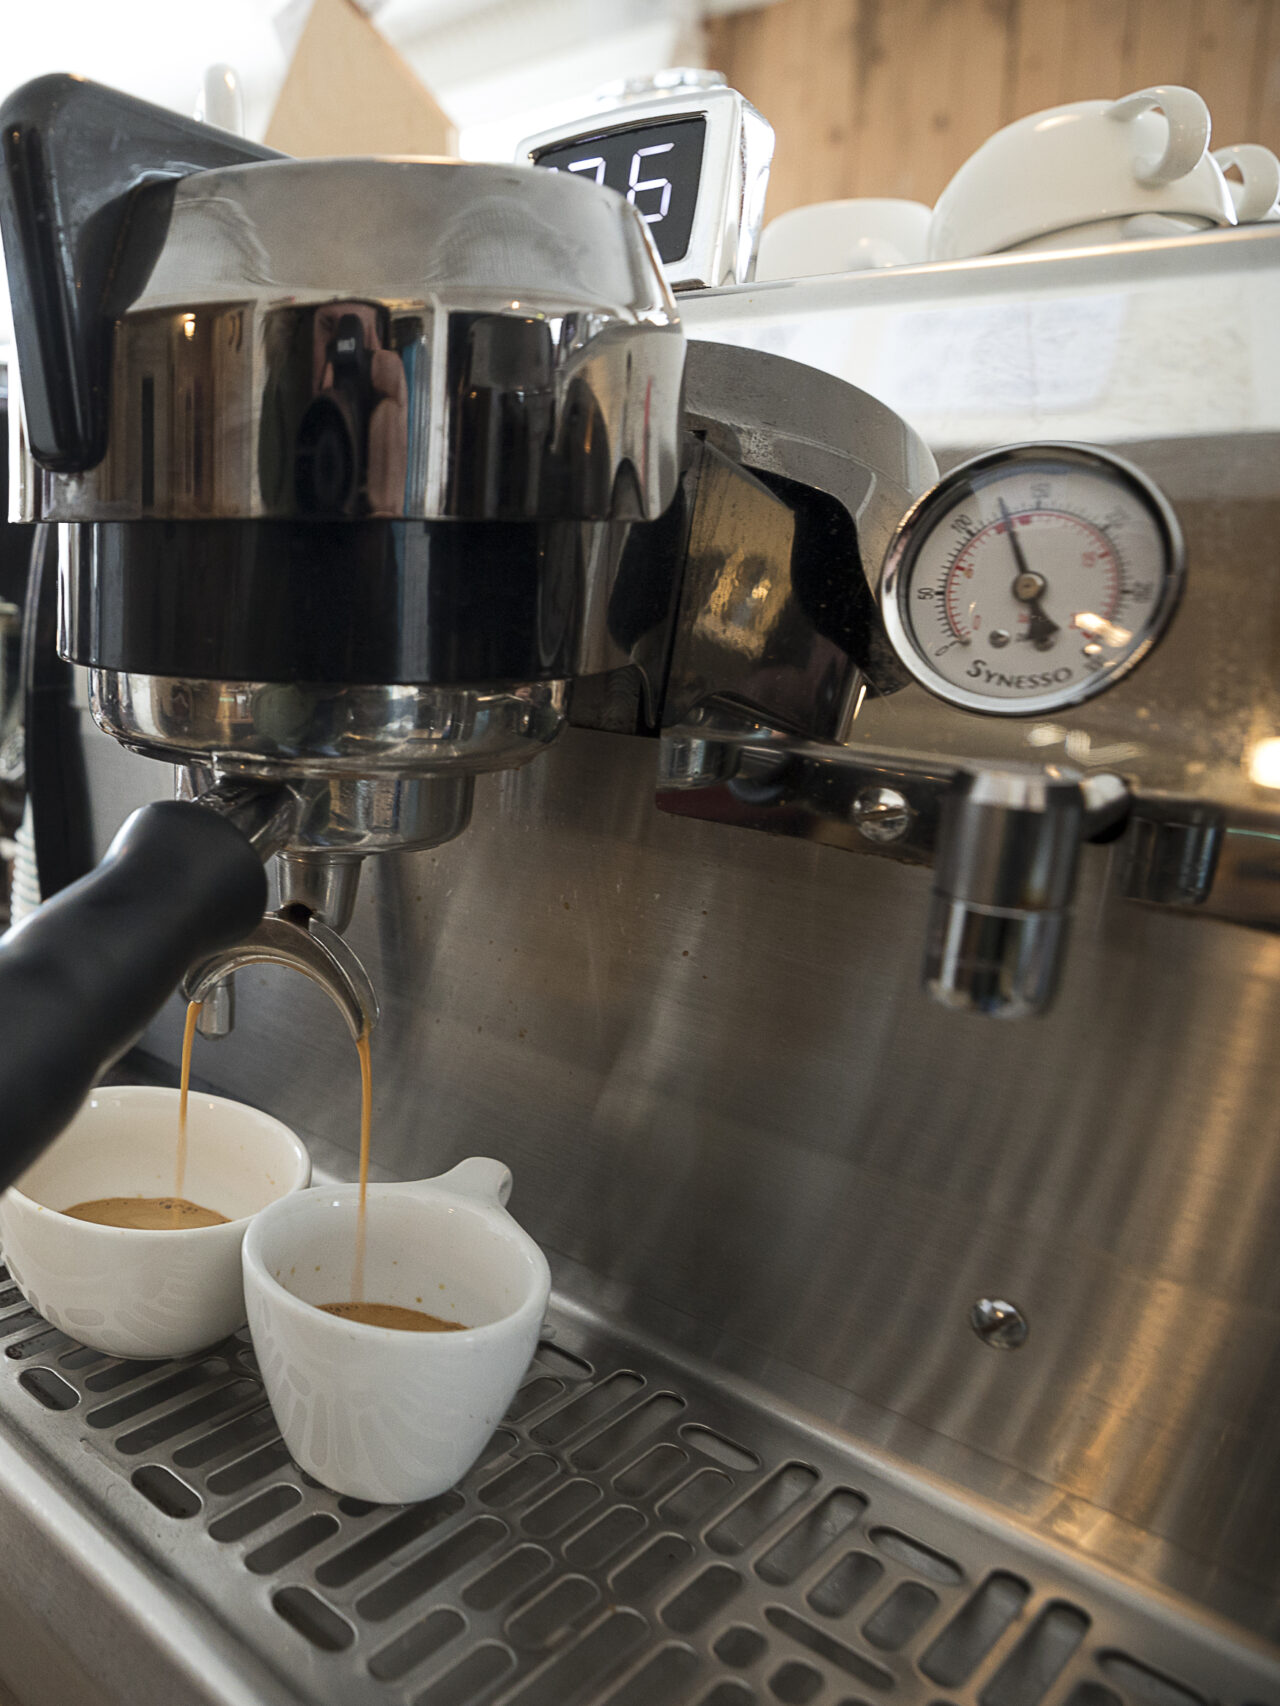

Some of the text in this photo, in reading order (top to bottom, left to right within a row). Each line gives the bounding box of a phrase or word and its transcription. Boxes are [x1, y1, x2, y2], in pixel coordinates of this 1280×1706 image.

[951, 514, 971, 534] 100
[918, 587, 934, 600] 50
[966, 659, 1073, 689] SYNESSO
